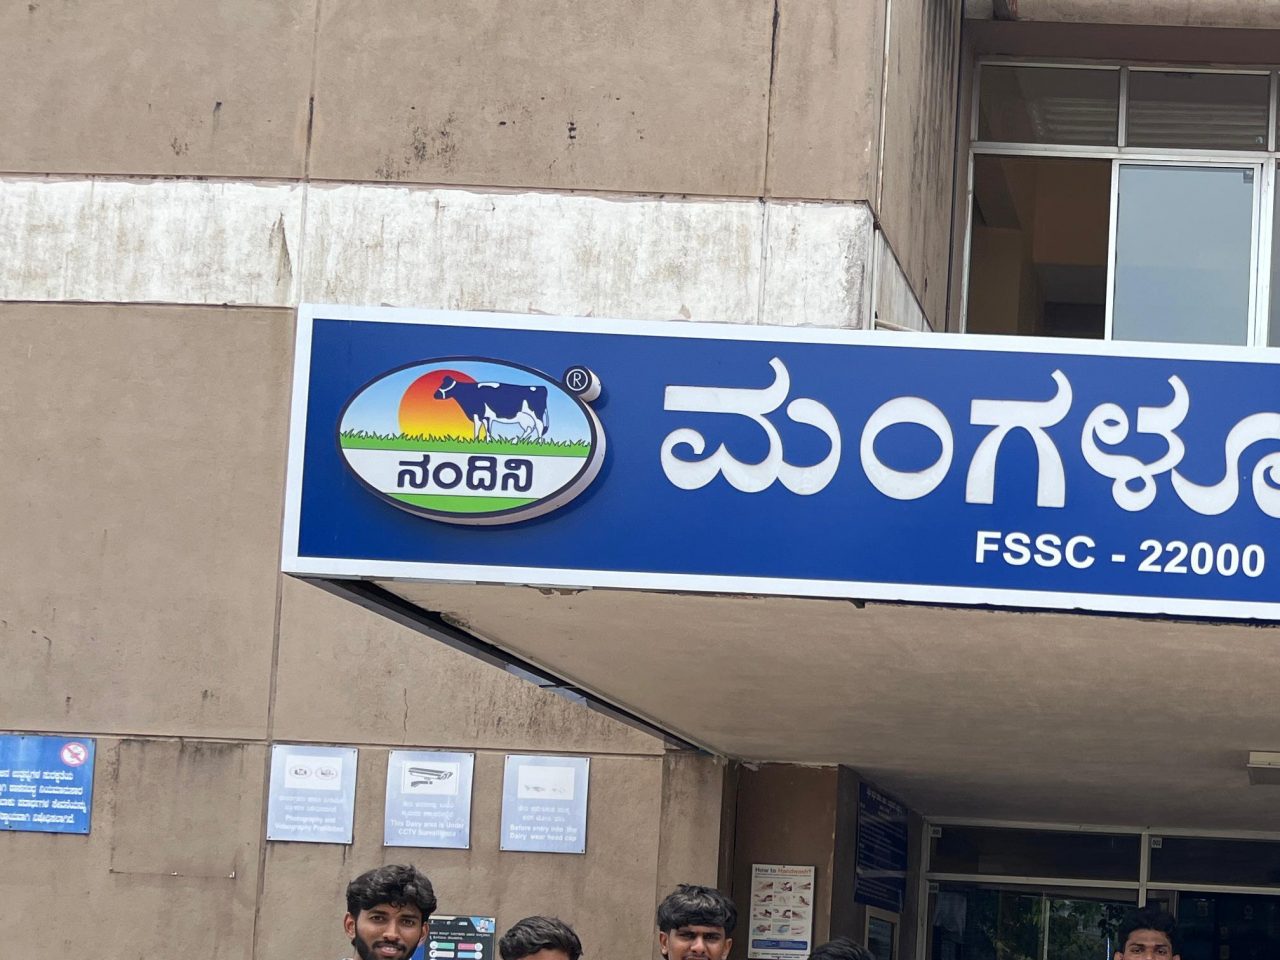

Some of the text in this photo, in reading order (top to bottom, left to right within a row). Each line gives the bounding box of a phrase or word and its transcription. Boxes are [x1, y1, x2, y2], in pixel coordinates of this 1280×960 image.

[397, 454, 533, 492] ನಂದಿನಿ
[975, 530, 1096, 569] FSSC
[1137, 540, 1265, 578] 22000
